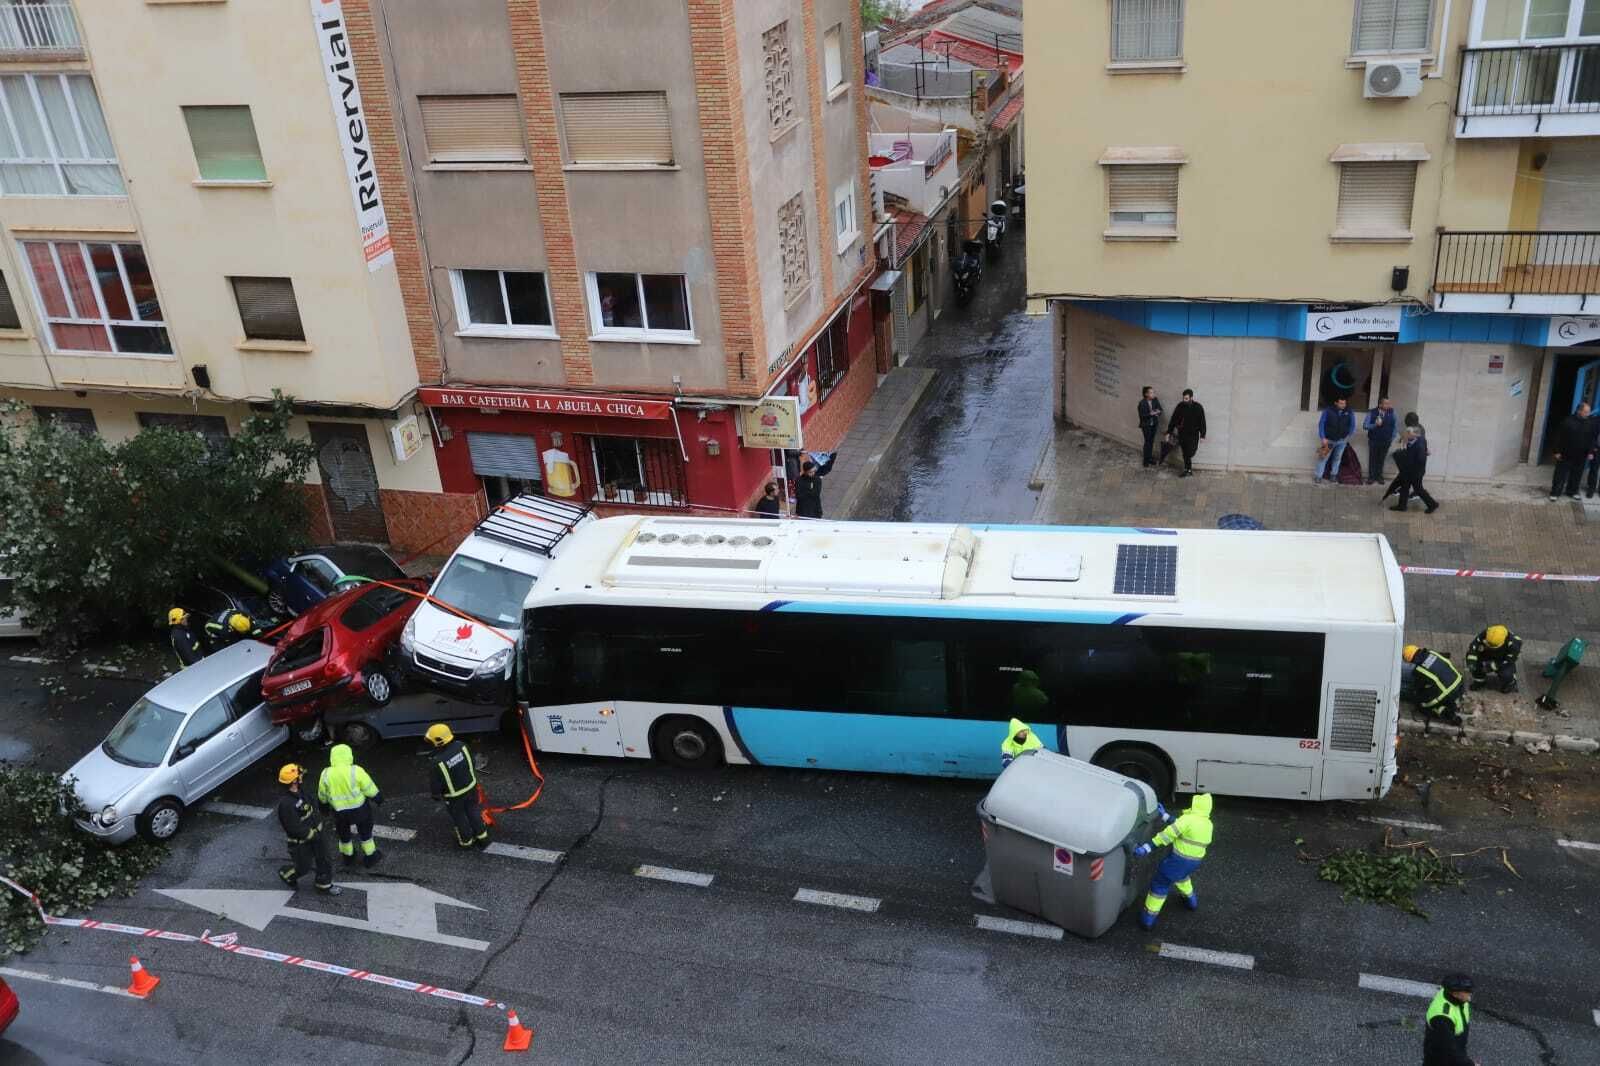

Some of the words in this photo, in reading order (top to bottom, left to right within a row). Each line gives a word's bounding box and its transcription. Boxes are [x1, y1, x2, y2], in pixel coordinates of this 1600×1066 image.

[322, 19, 378, 212] Rivervial
[442, 394, 465, 405] BAR
[536, 399, 551, 410] LA
[556, 401, 602, 413] ABUELA
[606, 403, 644, 416] CHICA
[1299, 740, 1321, 750] 622
